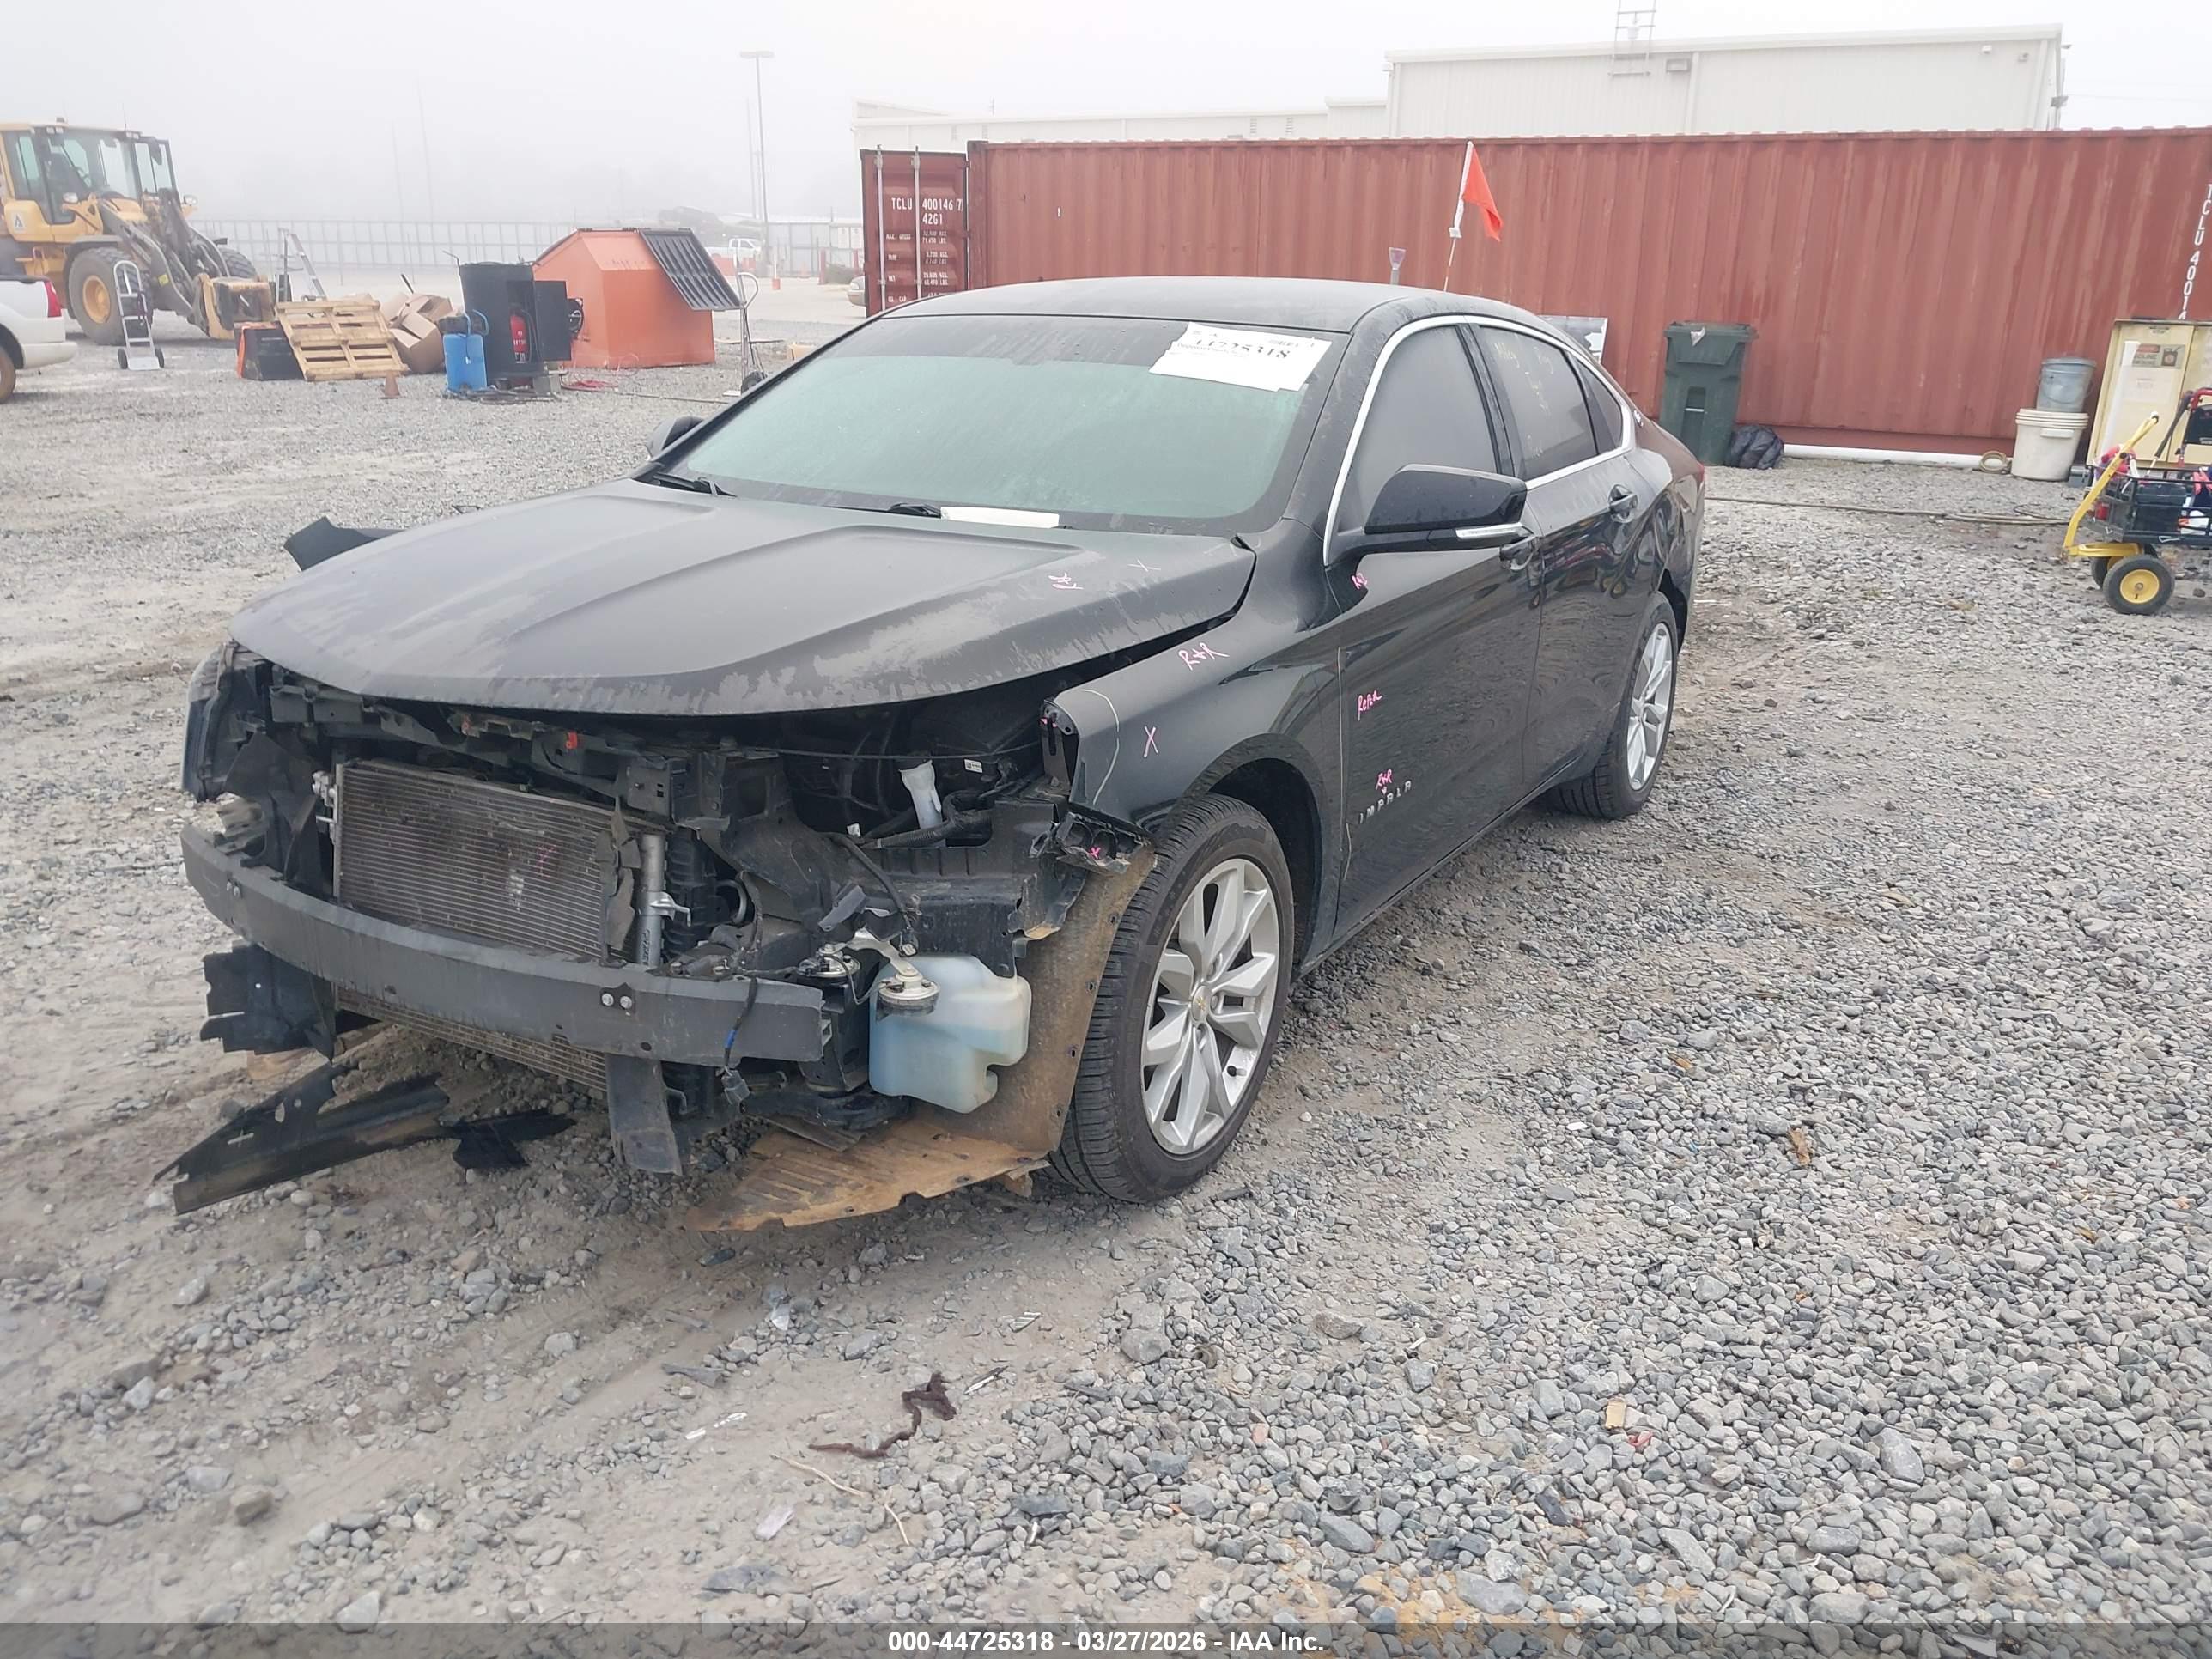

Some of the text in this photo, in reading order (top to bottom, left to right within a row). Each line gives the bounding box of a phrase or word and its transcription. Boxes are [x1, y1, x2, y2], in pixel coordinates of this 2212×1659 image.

[891, 198, 913, 210] TCLU
[922, 198, 953, 211] 400146
[922, 213, 943, 225] 42G1
[1144, 726, 1159, 757] X
[1359, 780, 1412, 824] IMPALA
